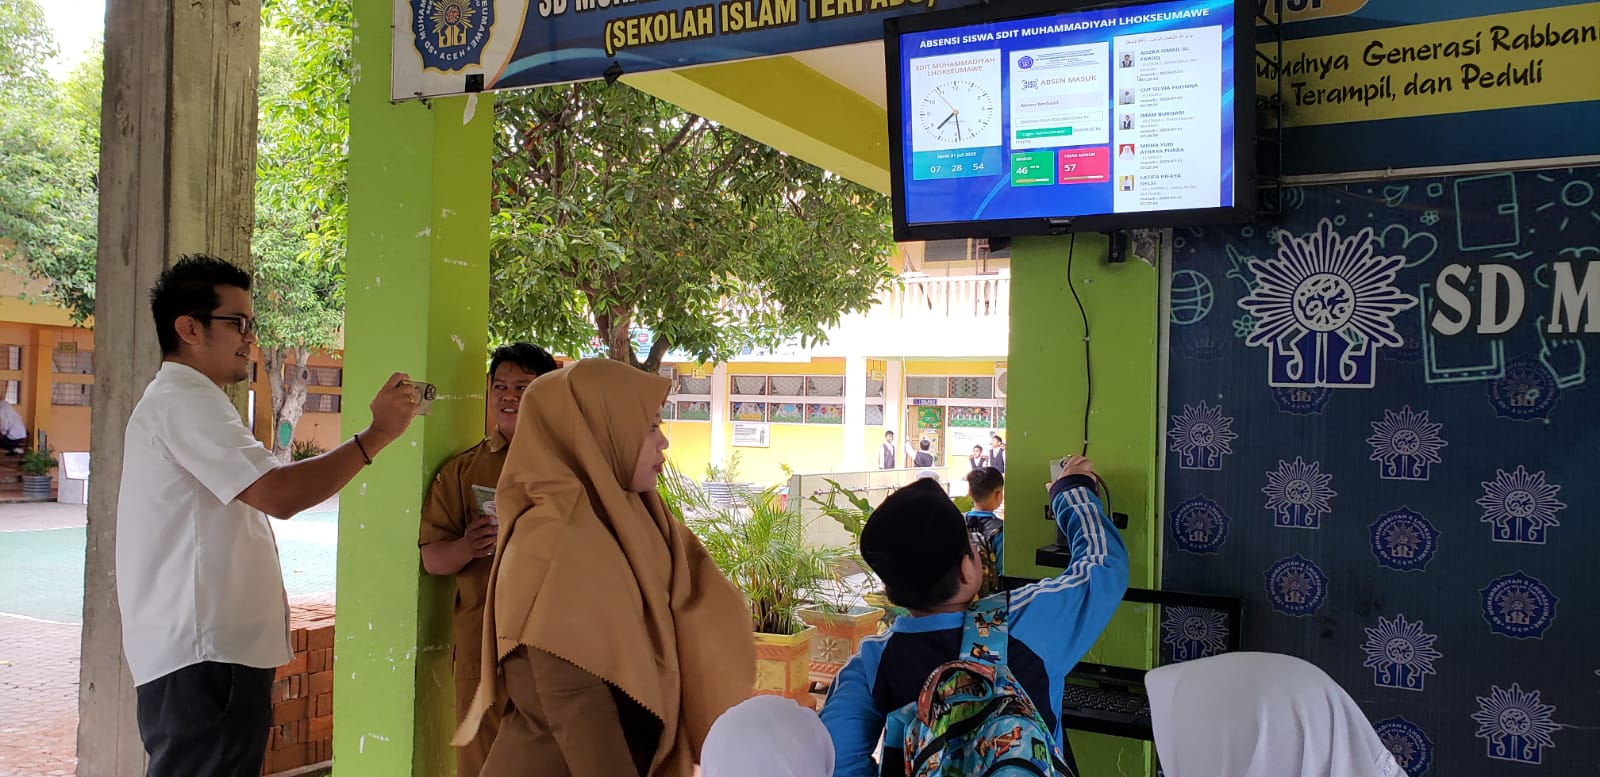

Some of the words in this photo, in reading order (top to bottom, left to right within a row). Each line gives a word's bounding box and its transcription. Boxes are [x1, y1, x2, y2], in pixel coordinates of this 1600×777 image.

[605, 6, 713, 55] (SEKOLAH
[721, 1, 796, 32] ISLAM
[919, 36, 960, 49] ABSENSI
[961, 32, 994, 44] SISWA
[995, 29, 1019, 40] SDIT
[1021, 18, 1116, 37] MUHAMMADIYAH
[1119, 8, 1210, 26] LHOKSEUMAWE
[439, 49, 466, 61] ACEH
[1256, 52, 1350, 81] ujudnya
[1363, 31, 1481, 66] Generasi
[1490, 21, 1600, 52] Rabban
[1040, 77, 1066, 86] ABSEN
[1068, 74, 1097, 83] MASUK
[1291, 75, 1396, 107] Terampil,
[1404, 72, 1452, 96] dan
[1461, 59, 1543, 90] Peduli
[930, 165, 941, 174] 07
[951, 164, 963, 172] 28
[972, 163, 984, 171] 54
[1016, 166, 1029, 175] 46
[1063, 163, 1076, 172] 57
[1432, 263, 1525, 336] SD
[1547, 261, 1600, 334] M
